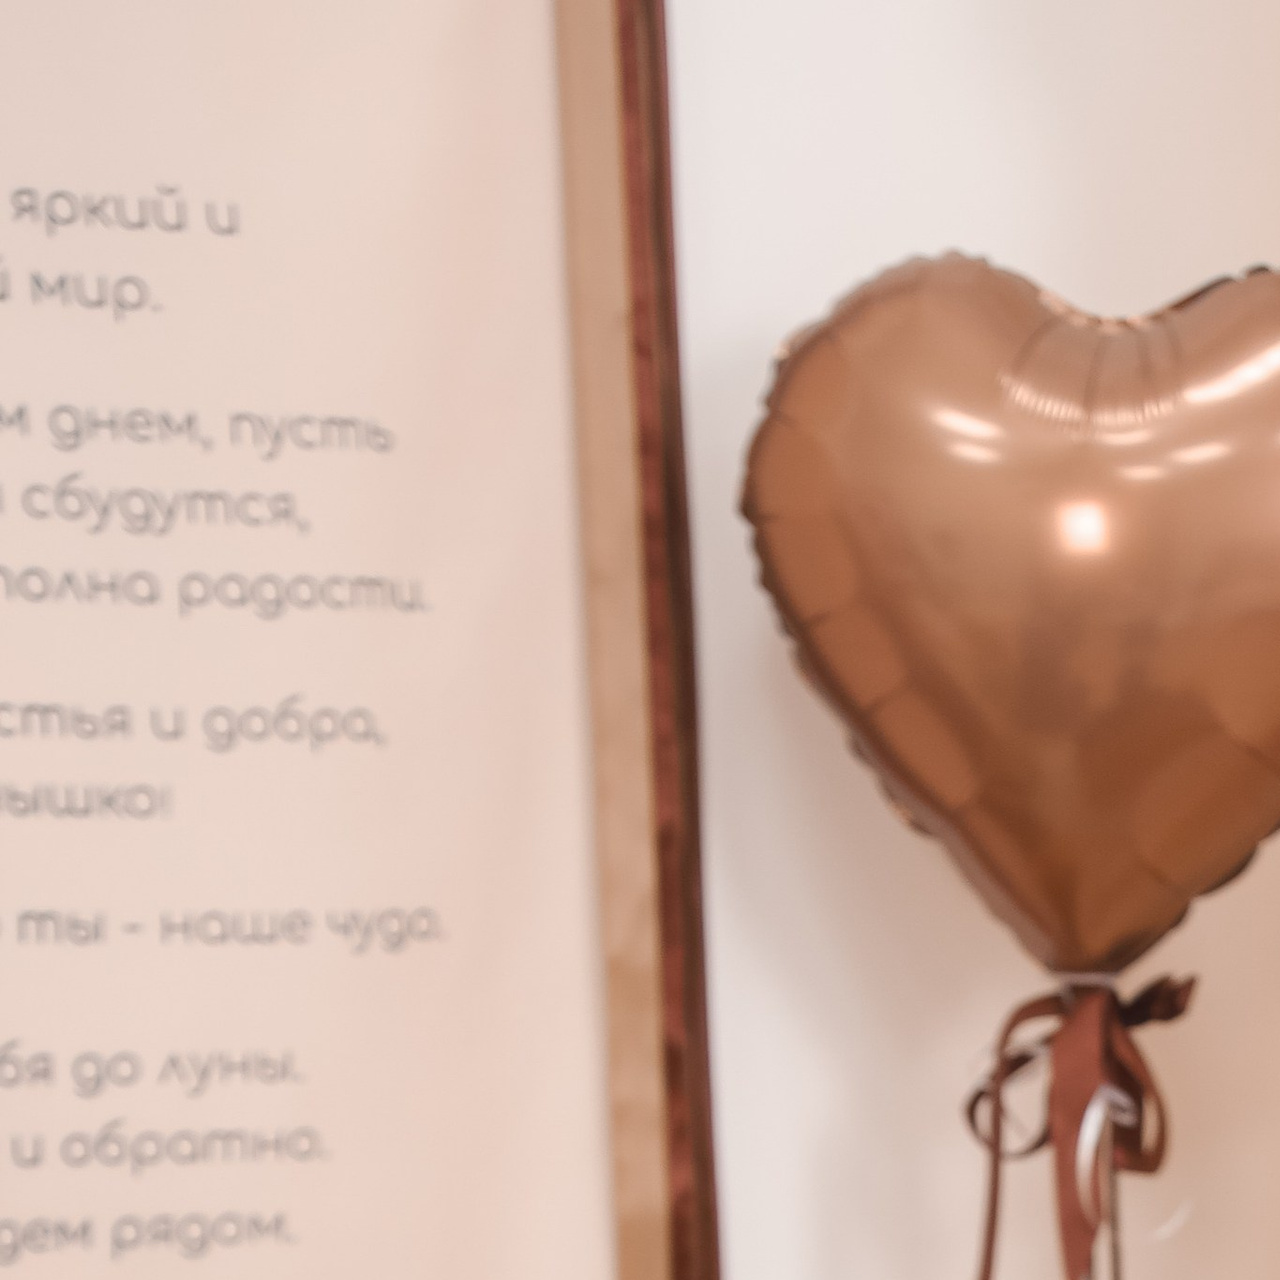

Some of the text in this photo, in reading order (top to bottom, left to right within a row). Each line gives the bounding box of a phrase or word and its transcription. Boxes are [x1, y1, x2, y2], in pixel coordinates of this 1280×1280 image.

[9, 184, 241, 239] яркий и
[28, 270, 164, 324] мир.
[46, 403, 216, 454] днем,
[226, 410, 396, 463] пусть
[20, 470, 312, 537] сбудутся,
[149, 706, 188, 743] и
[15, 907, 108, 948] ты
[158, 908, 315, 948] наше
[69, 1050, 145, 1100] до
[9, 1134, 46, 1171] и
